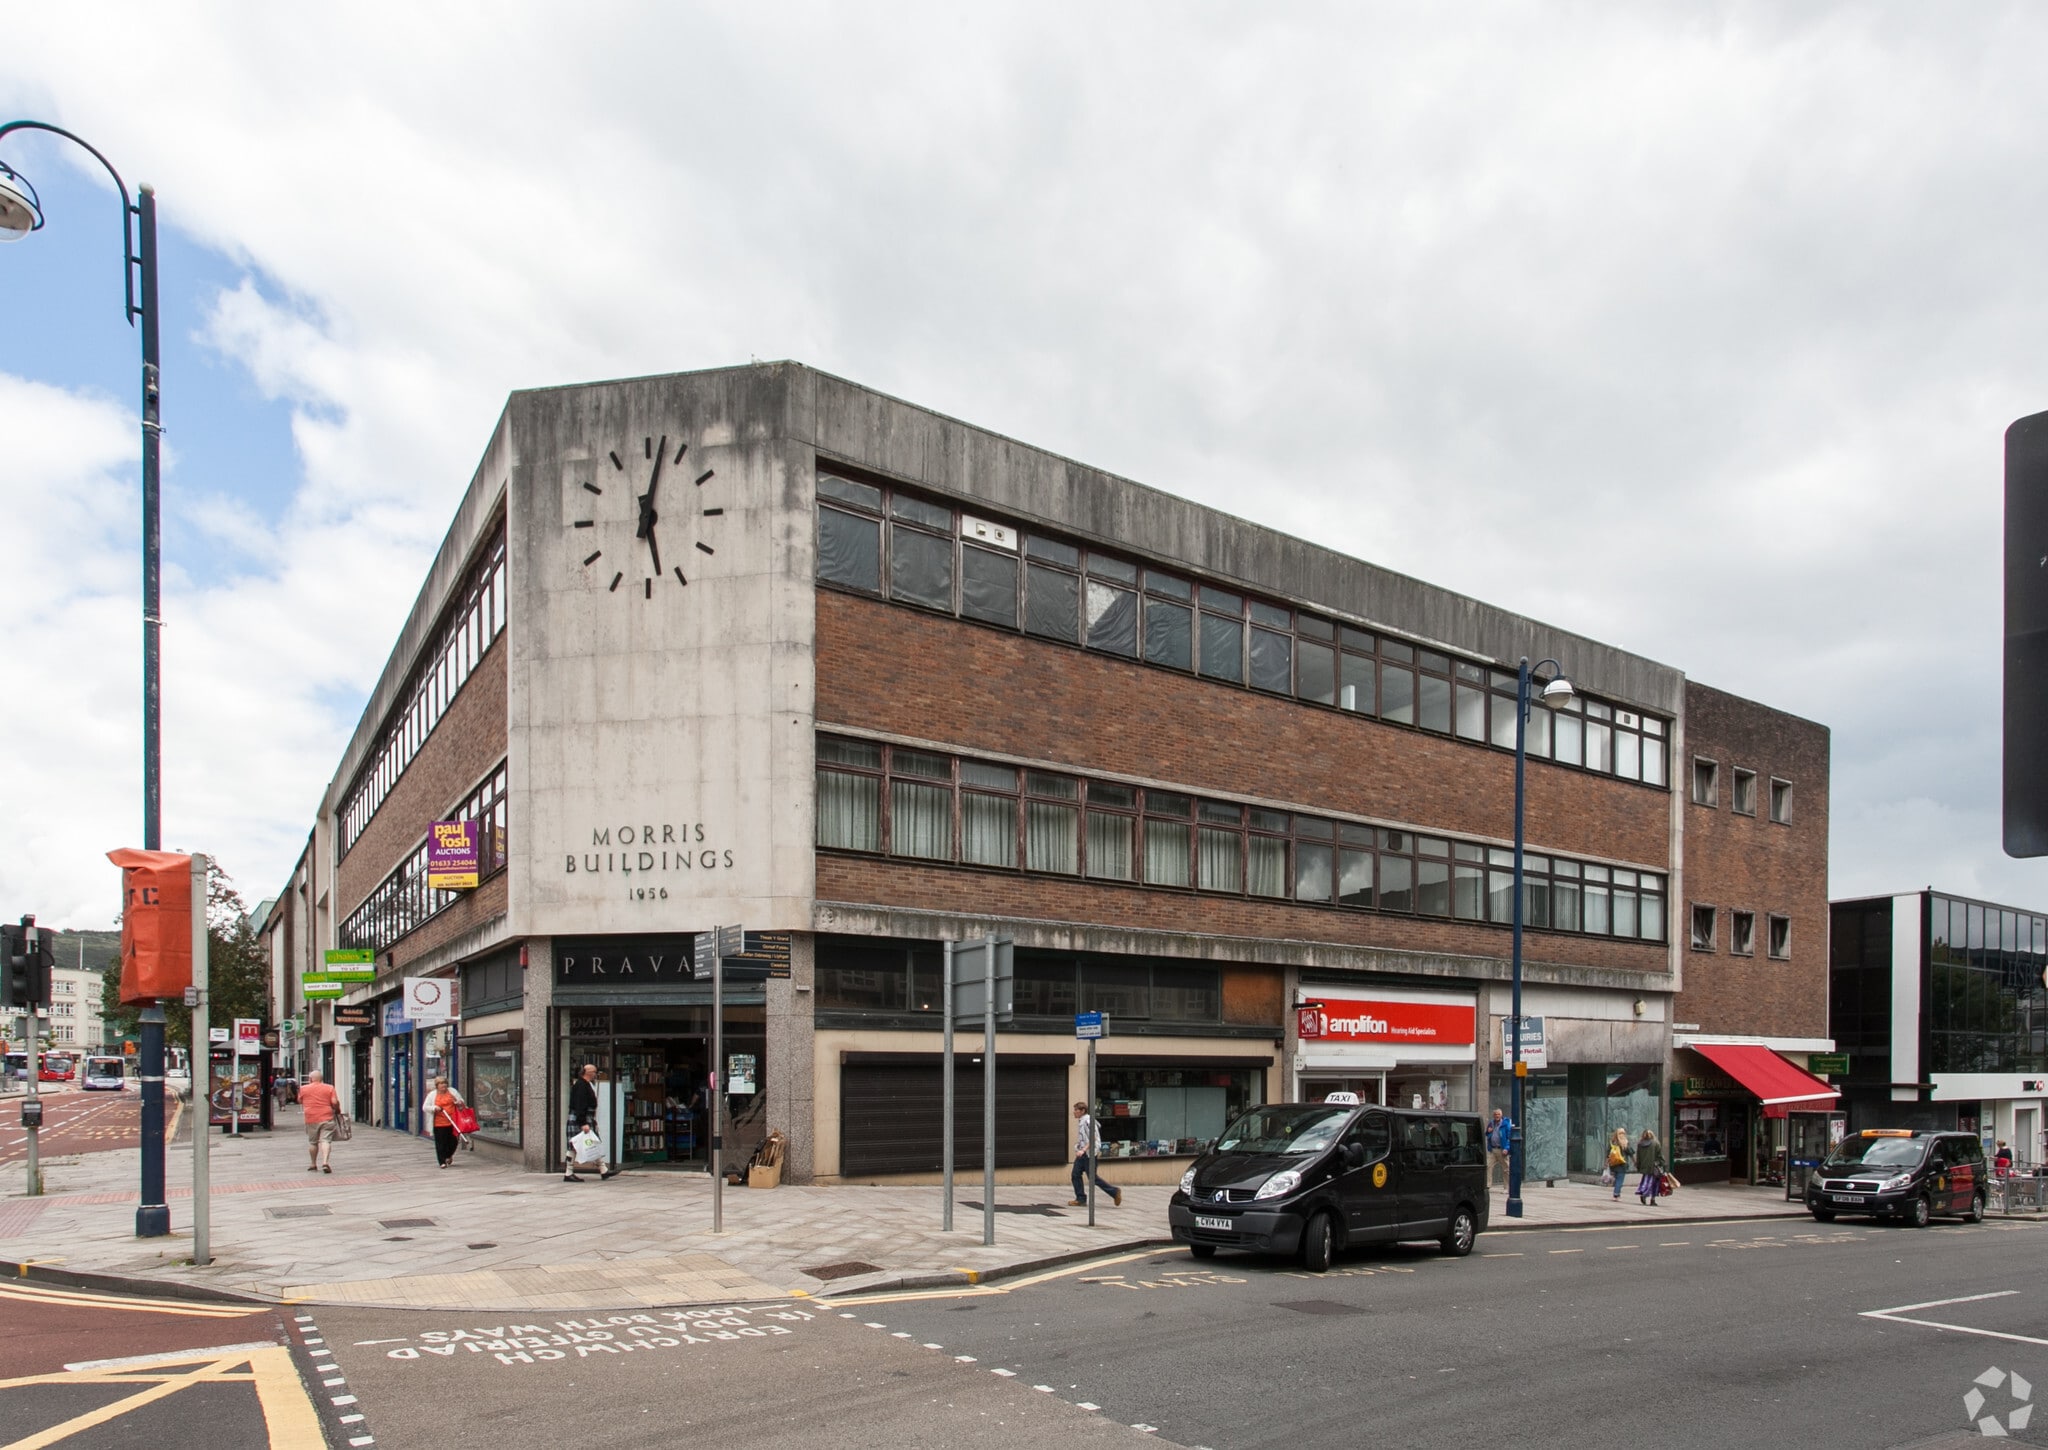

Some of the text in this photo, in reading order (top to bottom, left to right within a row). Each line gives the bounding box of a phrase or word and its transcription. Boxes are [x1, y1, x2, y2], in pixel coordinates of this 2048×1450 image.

[435, 822, 465, 838] paul
[592, 823, 705, 846] MORRIS
[440, 834, 470, 848] fosh
[566, 849, 733, 873] BUILDINGS
[629, 887, 668, 901] 1956
[1329, 1014, 1437, 1036] amplifon Hearing Aid Specialists
[1505, 1032, 1542, 1042] EUIRIES
[1329, 1094, 1351, 1102] TAXI
[1216, 1218, 1230, 1228] VYA
[1101, 1275, 1247, 1290] TAXIS
[419, 1306, 754, 1343] LOOK BOTH WAYS
[627, 1317, 750, 1336] DDAU
[387, 1330, 614, 1359] GYFEIRIAD
